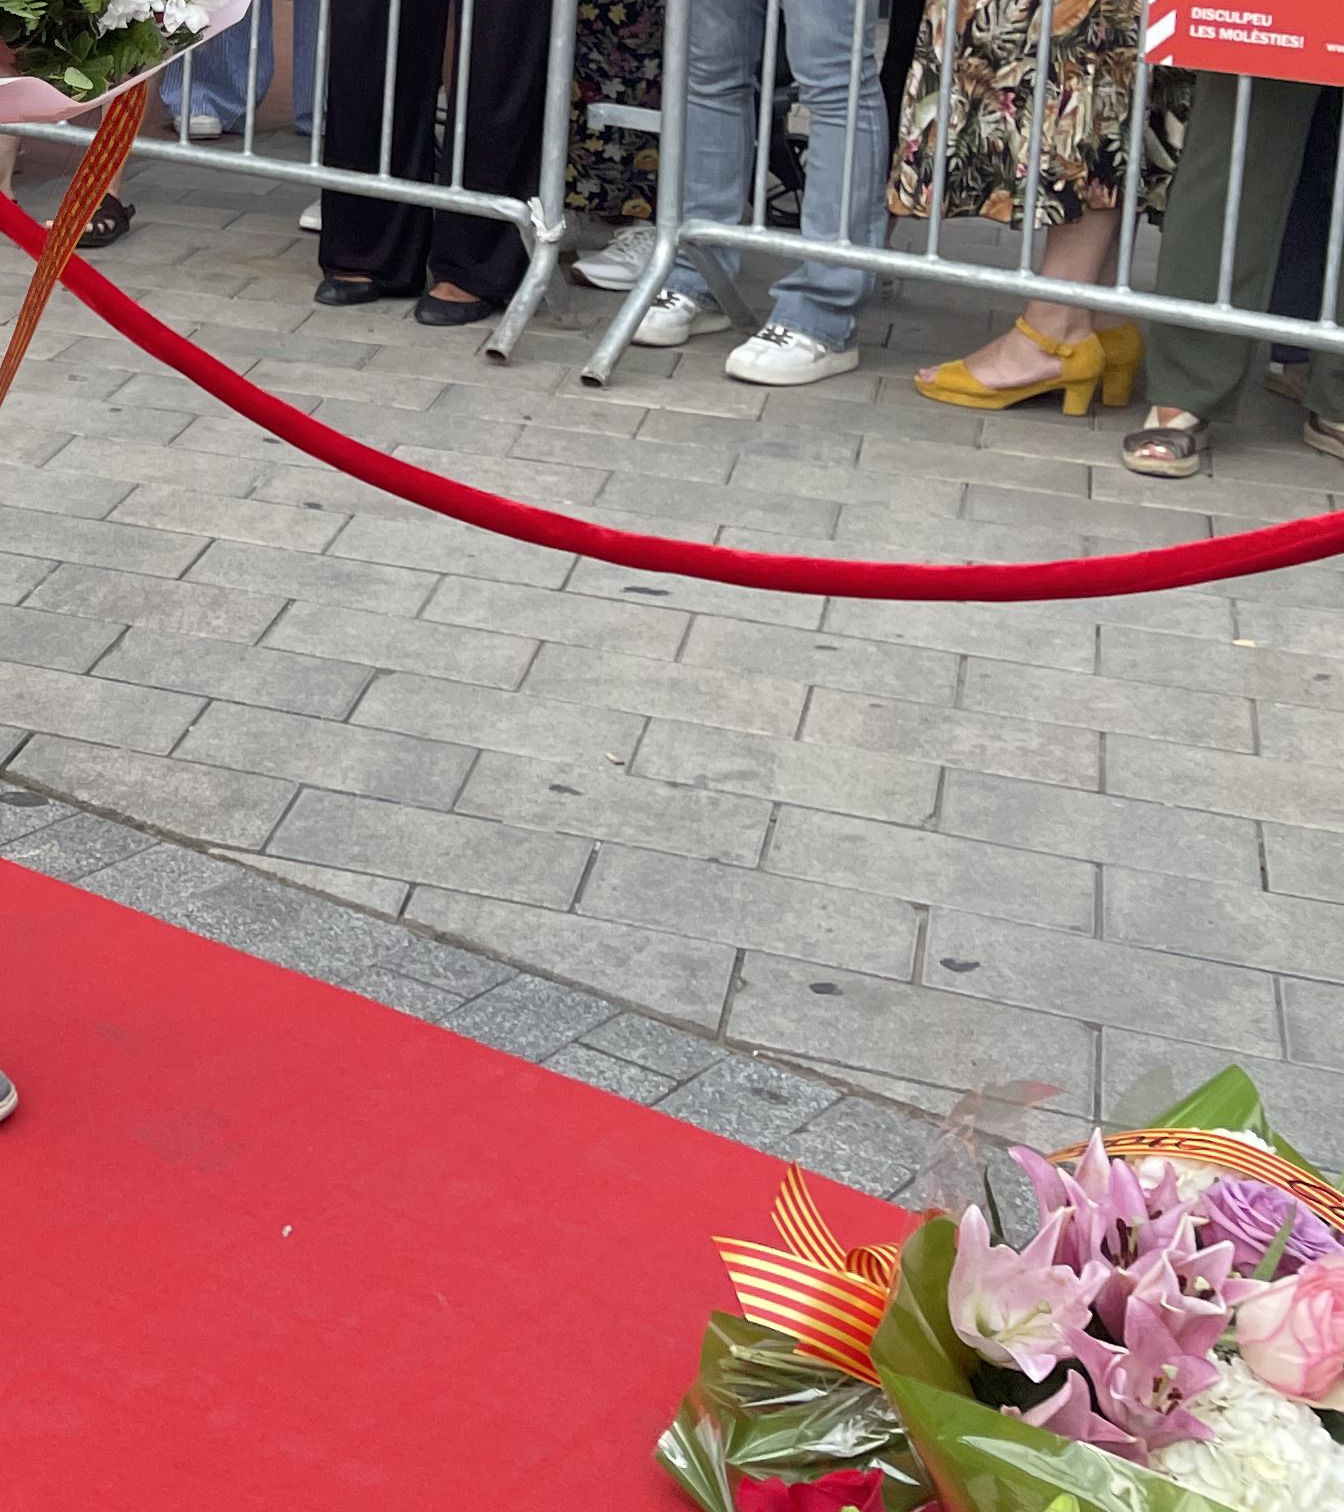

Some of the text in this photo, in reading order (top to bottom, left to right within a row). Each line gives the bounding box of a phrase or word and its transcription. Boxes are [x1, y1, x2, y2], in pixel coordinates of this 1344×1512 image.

[1190, 6, 1273, 27] DISCULPEU
[1189, 24, 1216, 39] LES
[1218, 27, 1305, 48] MOLÈSTIES!
